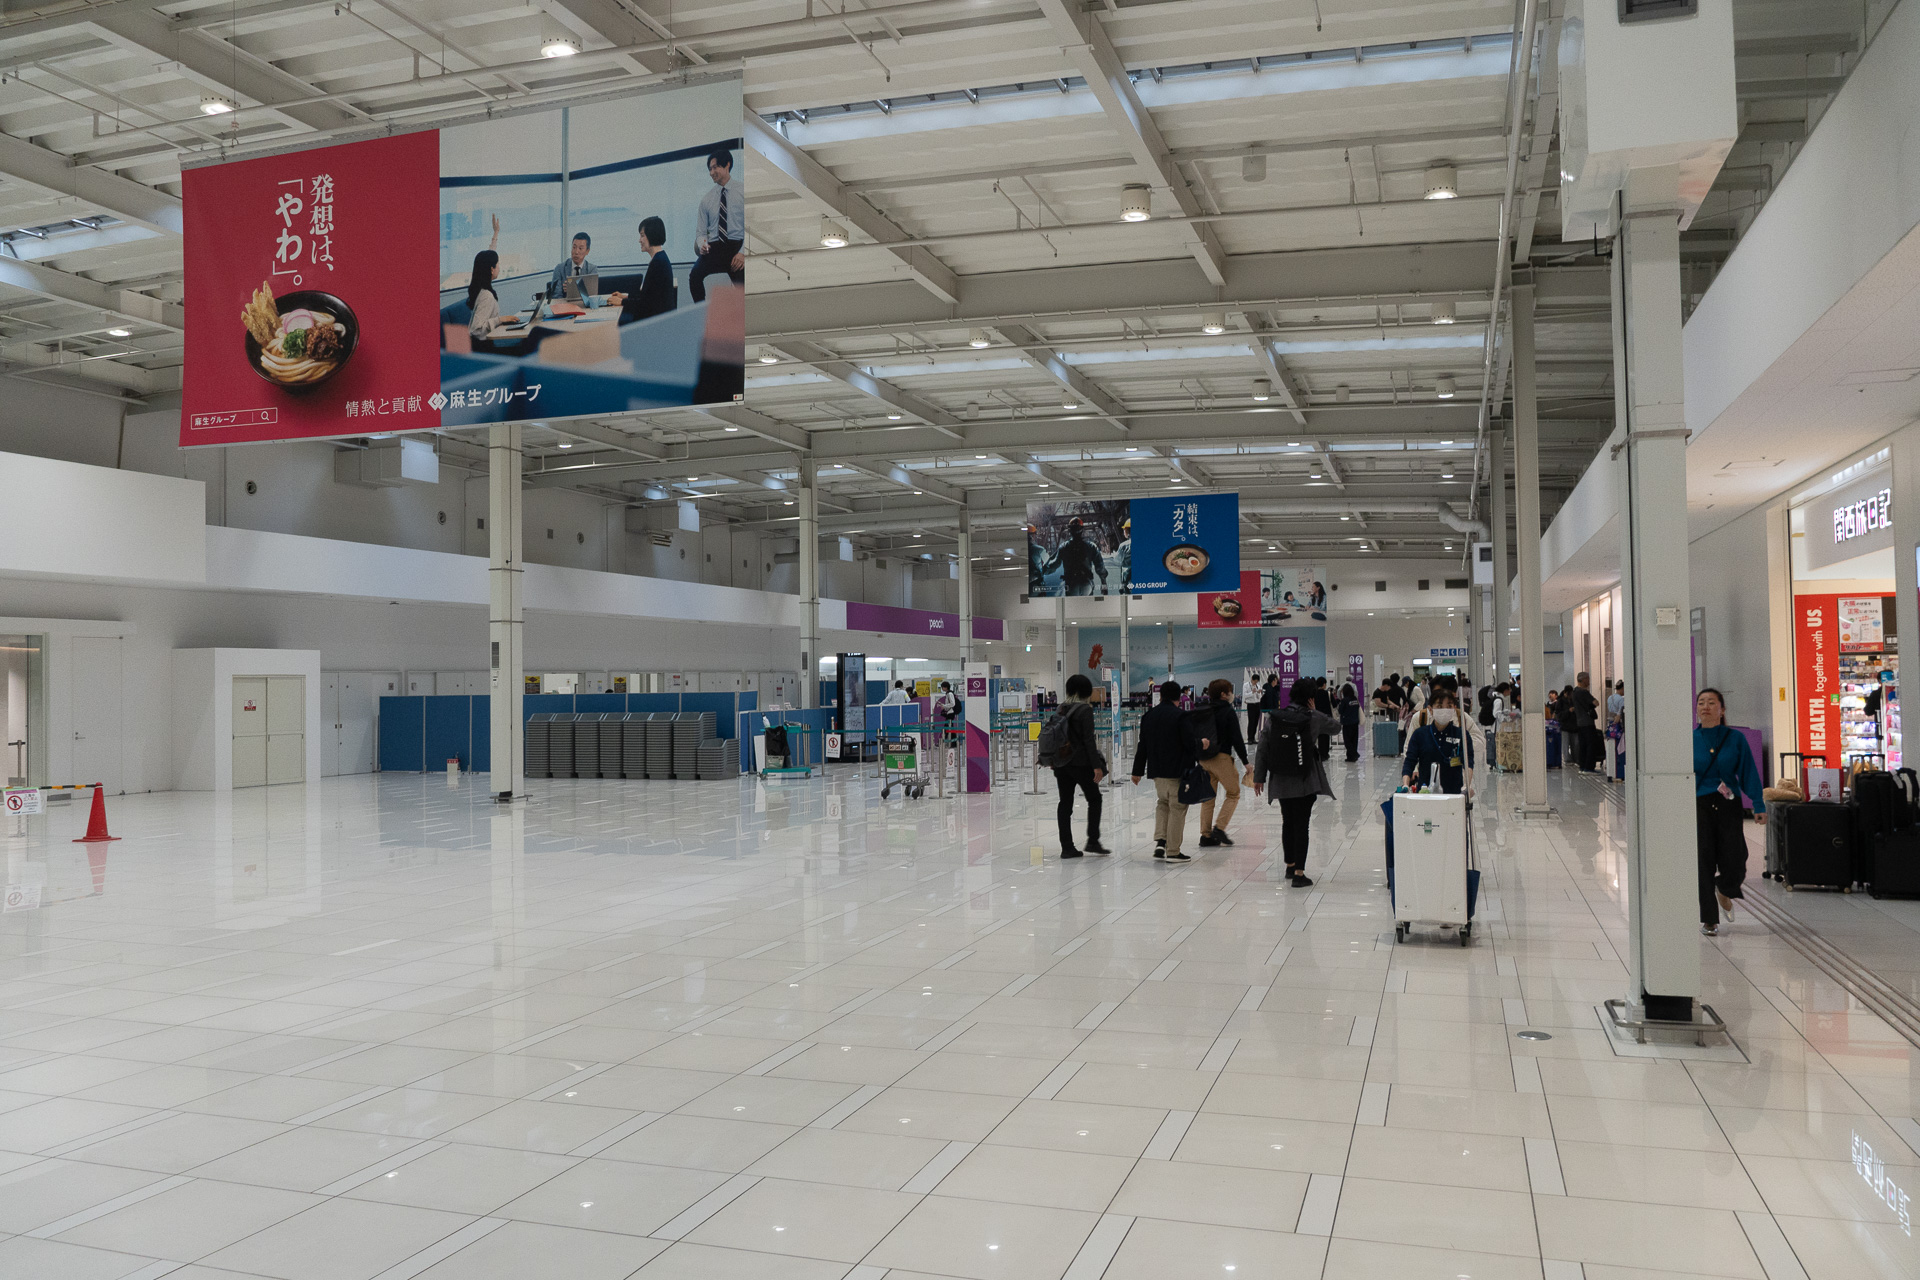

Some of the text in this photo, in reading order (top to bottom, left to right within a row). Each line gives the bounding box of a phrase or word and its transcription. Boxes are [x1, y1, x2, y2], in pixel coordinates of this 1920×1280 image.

[272, 178, 303, 286] 「やわ」。
[309, 173, 335, 271] 発想は、
[345, 394, 422, 418] 情熱と貢献
[449, 384, 542, 409] 麻生グループ
[194, 413, 237, 426] 麻生グループ
[1172, 504, 1186, 542] 「カタ」。
[1187, 503, 1199, 538] 結束は、
[929, 618, 944, 630] peach
[1807, 606, 1823, 627] US.
[1284, 641, 1293, 653] 3
[1812, 630, 1823, 650] with
[1812, 652, 1827, 692] together
[1809, 695, 1827, 750] HEALTH,
